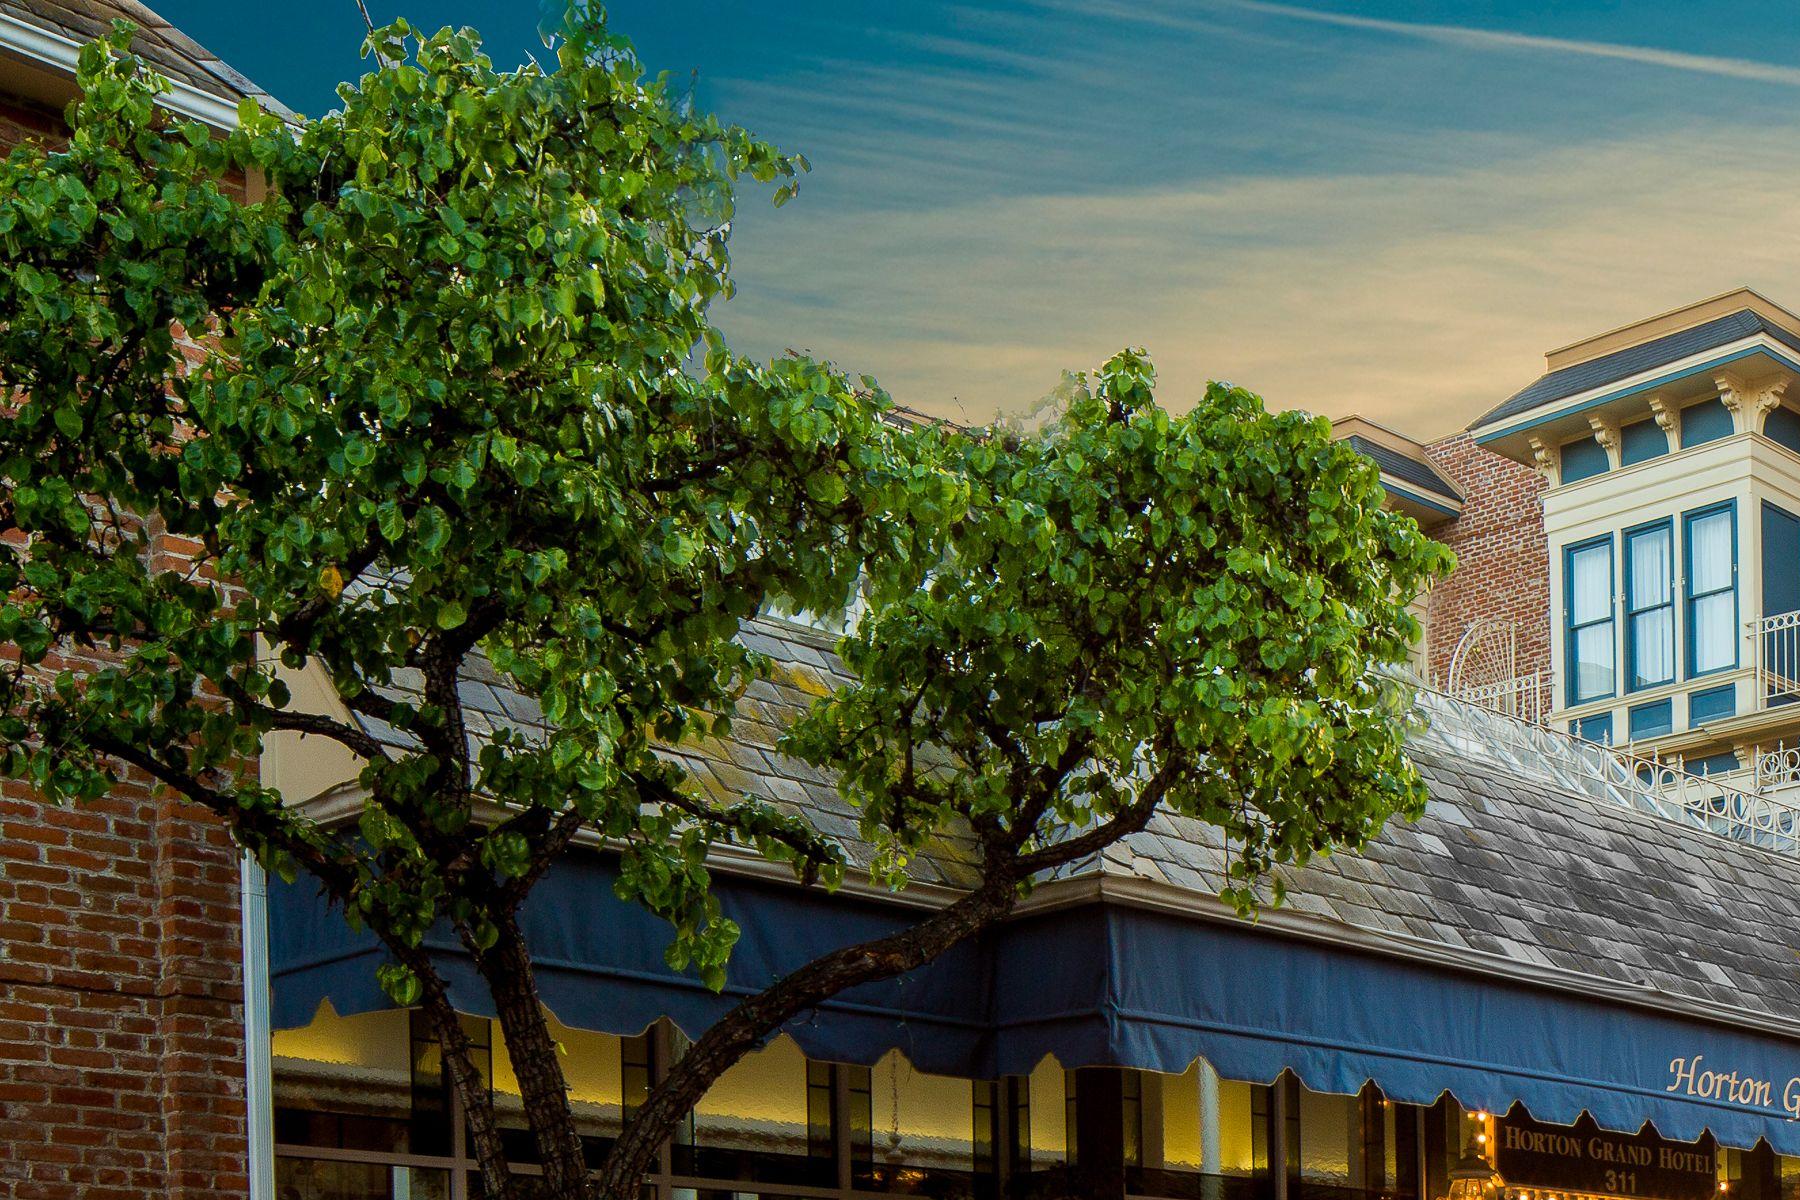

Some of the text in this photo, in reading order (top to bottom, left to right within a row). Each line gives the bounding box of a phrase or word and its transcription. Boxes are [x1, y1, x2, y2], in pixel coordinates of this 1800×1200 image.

[1666, 1055, 1773, 1107] Horton
[1505, 1125, 1713, 1175] HORTON GRAND HOTEL
[1605, 1169, 1636, 1194] 311
